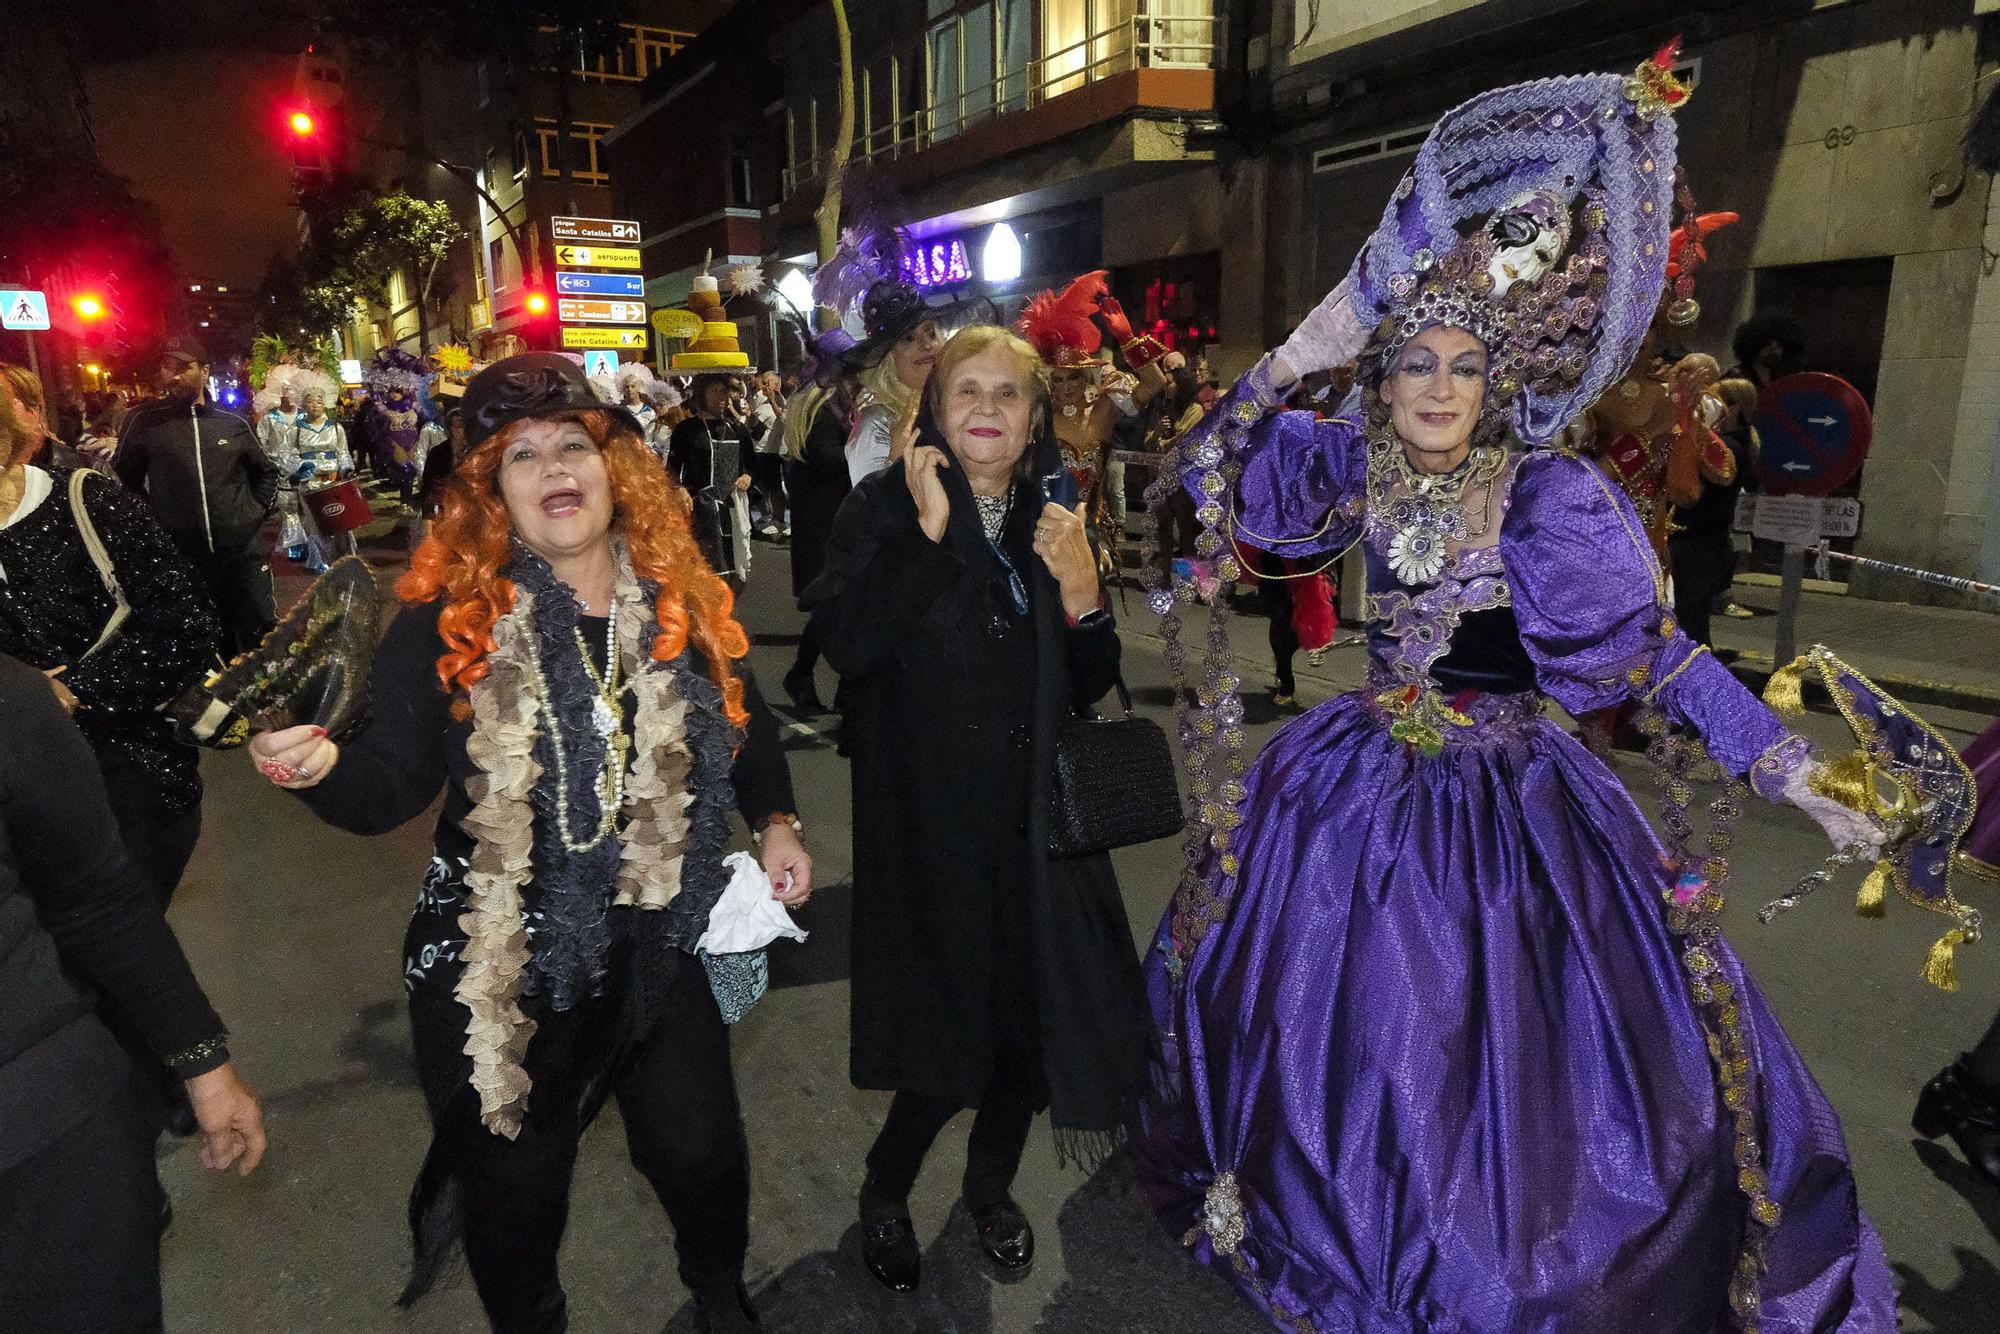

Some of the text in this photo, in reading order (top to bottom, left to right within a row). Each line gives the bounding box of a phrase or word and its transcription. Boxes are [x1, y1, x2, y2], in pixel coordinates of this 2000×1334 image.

[555, 227, 612, 237] Santa Catalina
[597, 254, 639, 262] aeropuerto
[626, 282, 641, 290] Sur
[562, 310, 576, 318] Las
